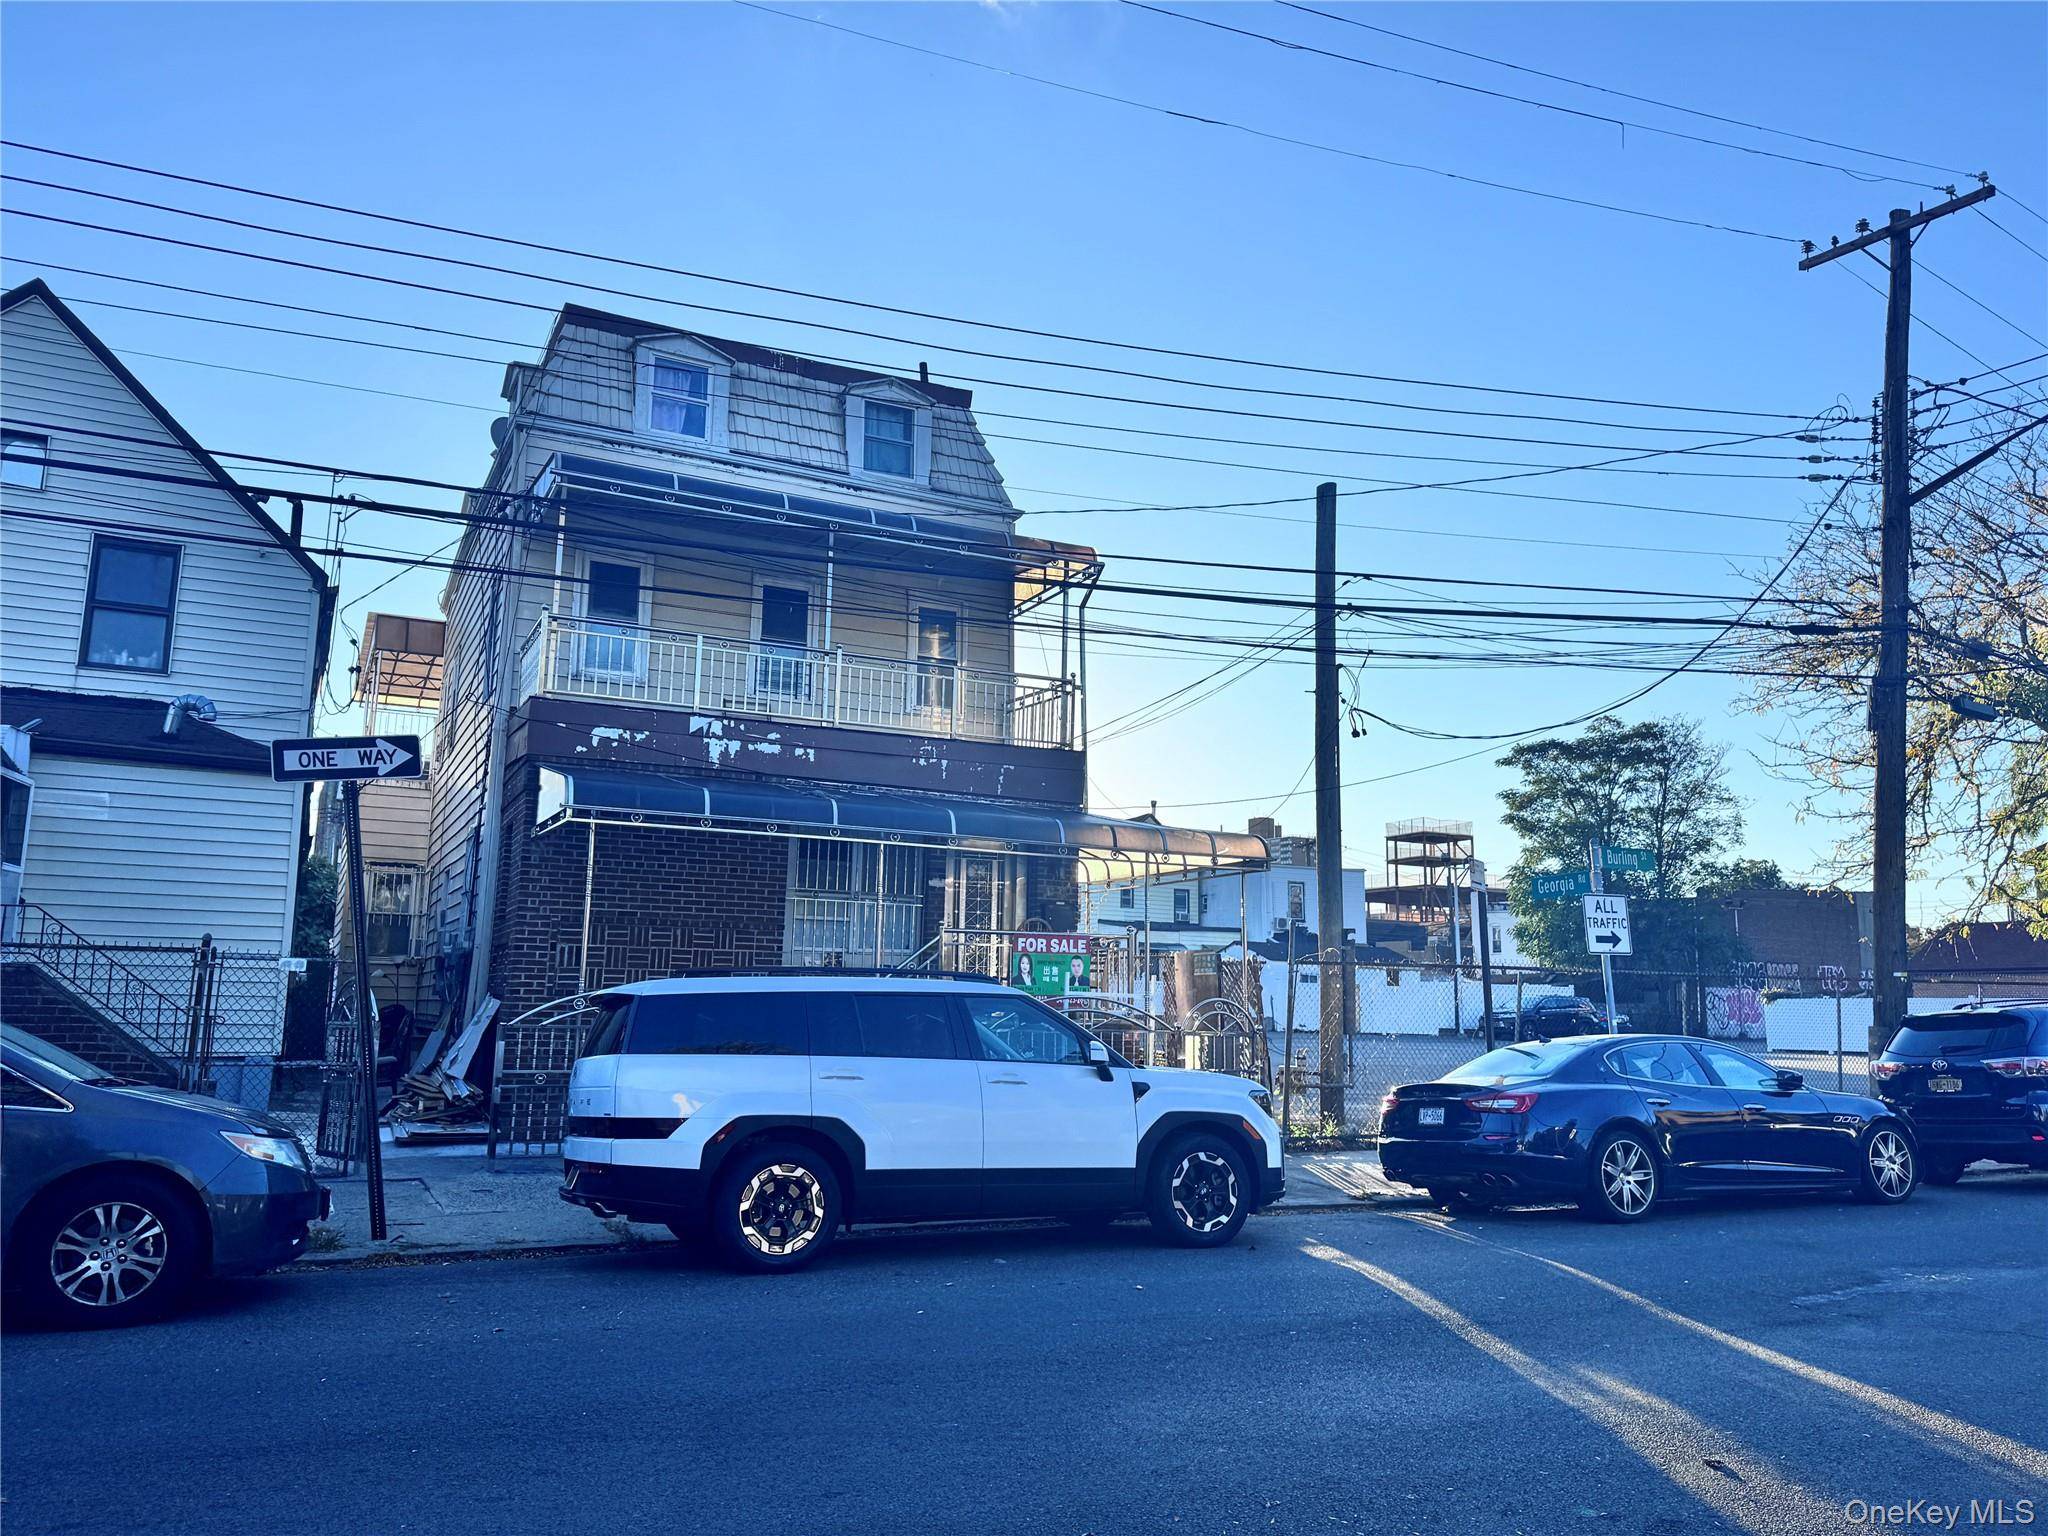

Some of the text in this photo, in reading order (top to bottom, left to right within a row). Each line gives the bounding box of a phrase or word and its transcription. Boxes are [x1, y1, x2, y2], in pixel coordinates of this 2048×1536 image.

[298, 748, 398, 768] ONE WAY
[1606, 849, 1638, 870] Burling
[1537, 874, 1586, 895] Georgia Rd
[1595, 898, 1618, 914] ALL
[1587, 916, 1627, 929] TRAFFIC
[1017, 937, 1087, 954] FOR SALE
